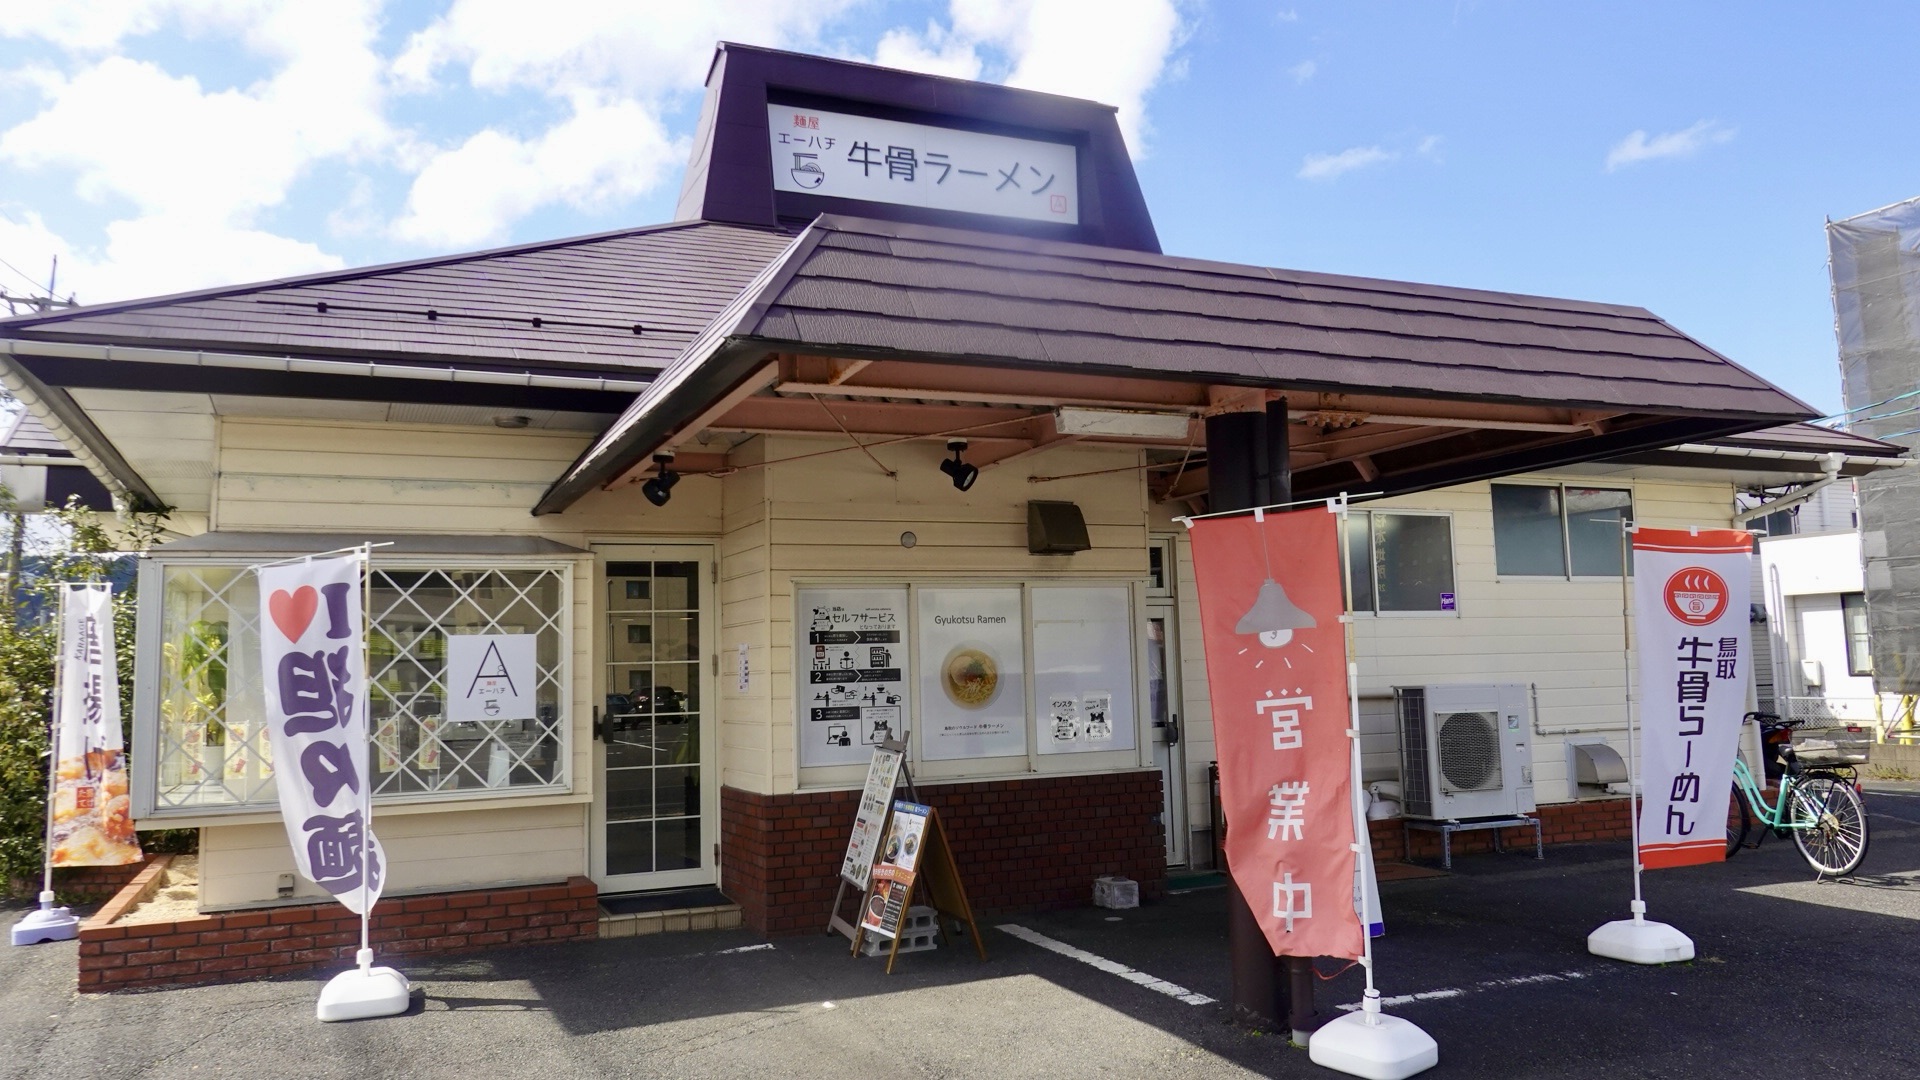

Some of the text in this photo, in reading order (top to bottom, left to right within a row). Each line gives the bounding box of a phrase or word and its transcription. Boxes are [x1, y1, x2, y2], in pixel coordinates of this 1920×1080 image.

[793, 114, 820, 130] 麺屋
[778, 132, 836, 150] エーハチ
[847, 140, 1055, 195] 牛骨ラーメン
[832, 612, 896, 624] セルフサービス
[934, 614, 1007, 626] Gyukotsu Ramen
[74, 618, 85, 661] KARAAGE
[814, 633, 820, 643] 1
[1715, 637, 1738, 679] 鳥取
[814, 671, 822, 682] 2
[815, 709, 823, 720] 3
[1665, 636, 1713, 836] 牛骨らーめん
[1255, 687, 1314, 933] 営業中
